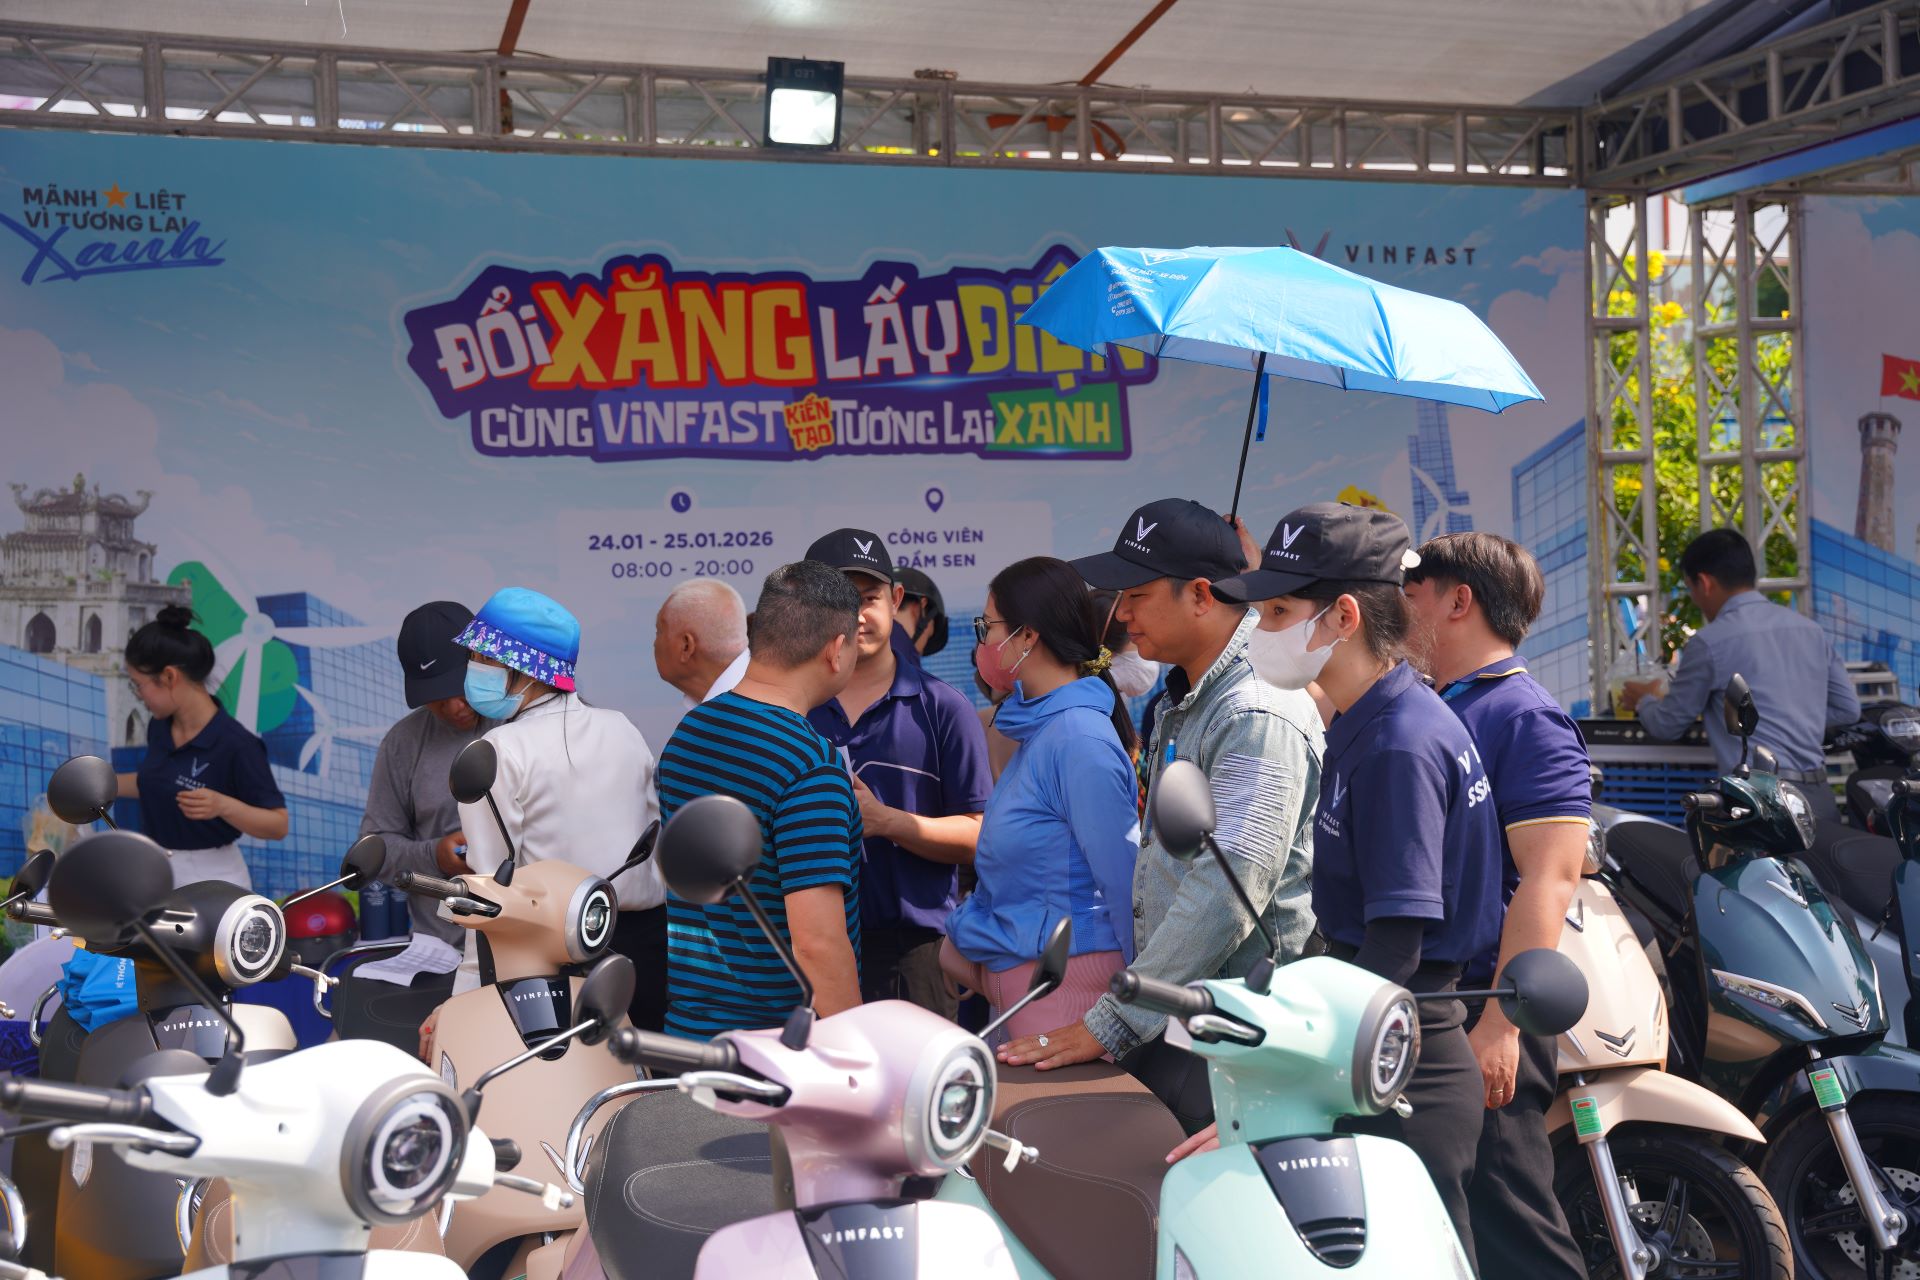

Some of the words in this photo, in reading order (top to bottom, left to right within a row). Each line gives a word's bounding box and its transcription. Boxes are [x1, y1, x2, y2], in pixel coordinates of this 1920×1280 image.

[22, 183, 98, 207] MÃNH
[135, 189, 186, 215] LIỆT
[24, 206, 49, 229] VÌ
[55, 210, 144, 231] TƯƠNG
[149, 215, 188, 233] LAI
[0, 211, 228, 286] Xanh
[1344, 244, 1477, 266] VINFAST
[536, 270, 815, 383] XĂNG
[818, 275, 959, 380] LẤY
[480, 404, 594, 447] CÙNG
[831, 400, 938, 445] TƯƠNG
[995, 401, 1112, 444] XANH
[792, 423, 832, 448] TẠO
[588, 534, 643, 551] 24.01
[664, 531, 774, 549] 25.01.2026
[888, 528, 937, 546] CÔNG
[944, 527, 983, 543] VIÊN
[1124, 539, 1151, 554] VINFAST
[1270, 550, 1300, 561] VINFAST
[611, 561, 672, 578] 08:00
[695, 559, 754, 576] 20:00
[943, 554, 976, 567] SEN
[515, 990, 564, 1002] VINFAST
[163, 1019, 220, 1032] VINFAST
[1277, 1156, 1350, 1172] VINFAST
[821, 1226, 905, 1245] VINFAST
